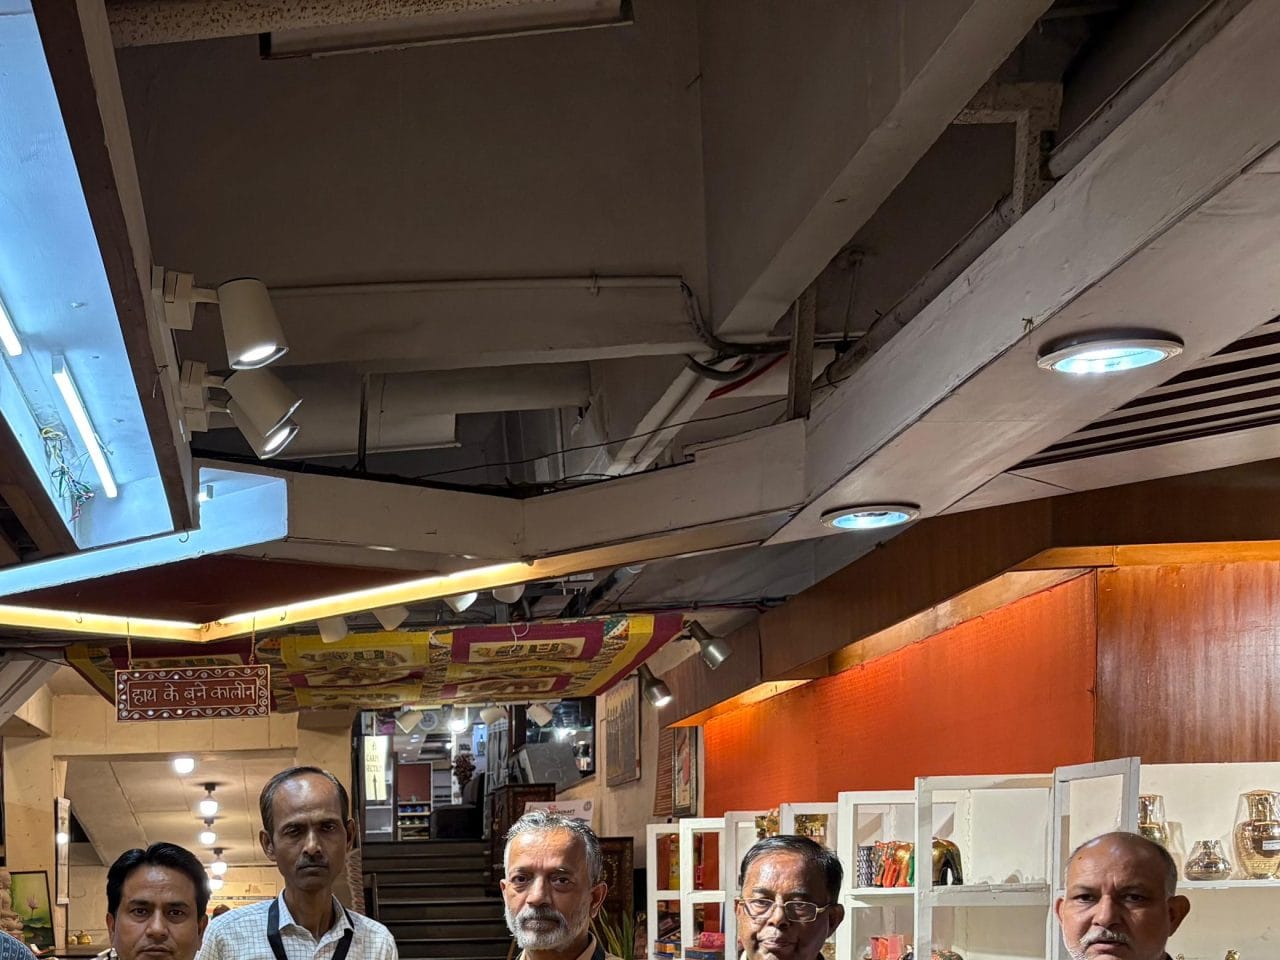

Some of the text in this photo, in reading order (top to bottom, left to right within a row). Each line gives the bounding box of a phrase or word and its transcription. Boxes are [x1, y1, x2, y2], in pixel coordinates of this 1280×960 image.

[132, 681, 255, 705] हाथ के बुने कालीन
